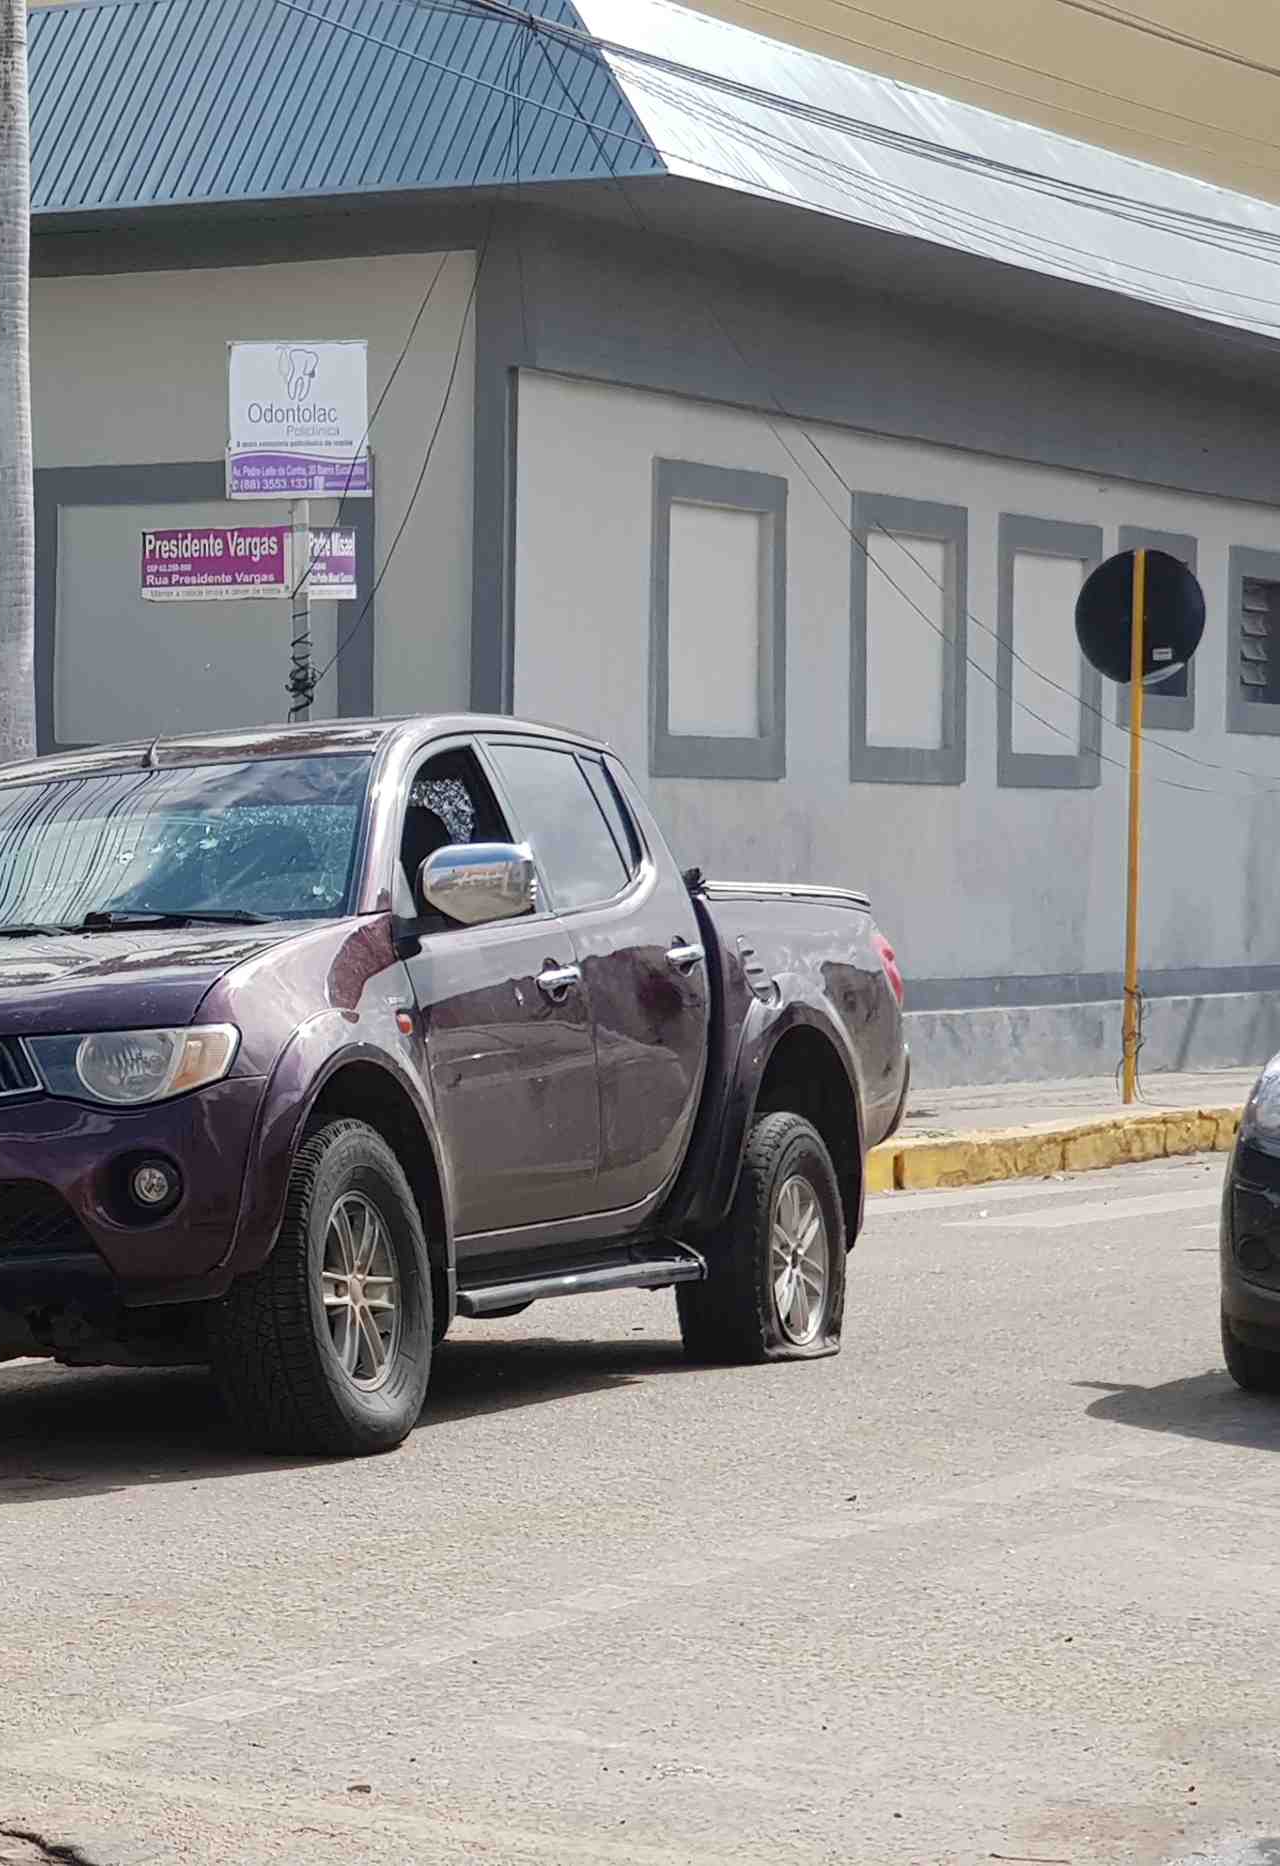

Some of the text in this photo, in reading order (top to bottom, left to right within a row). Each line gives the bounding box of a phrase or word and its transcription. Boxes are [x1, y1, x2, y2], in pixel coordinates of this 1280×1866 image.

[248, 403, 337, 423] Odontolac
[145, 531, 278, 562] Presidente Vargas
[146, 572, 275, 585] Rua Presidente Vargas
